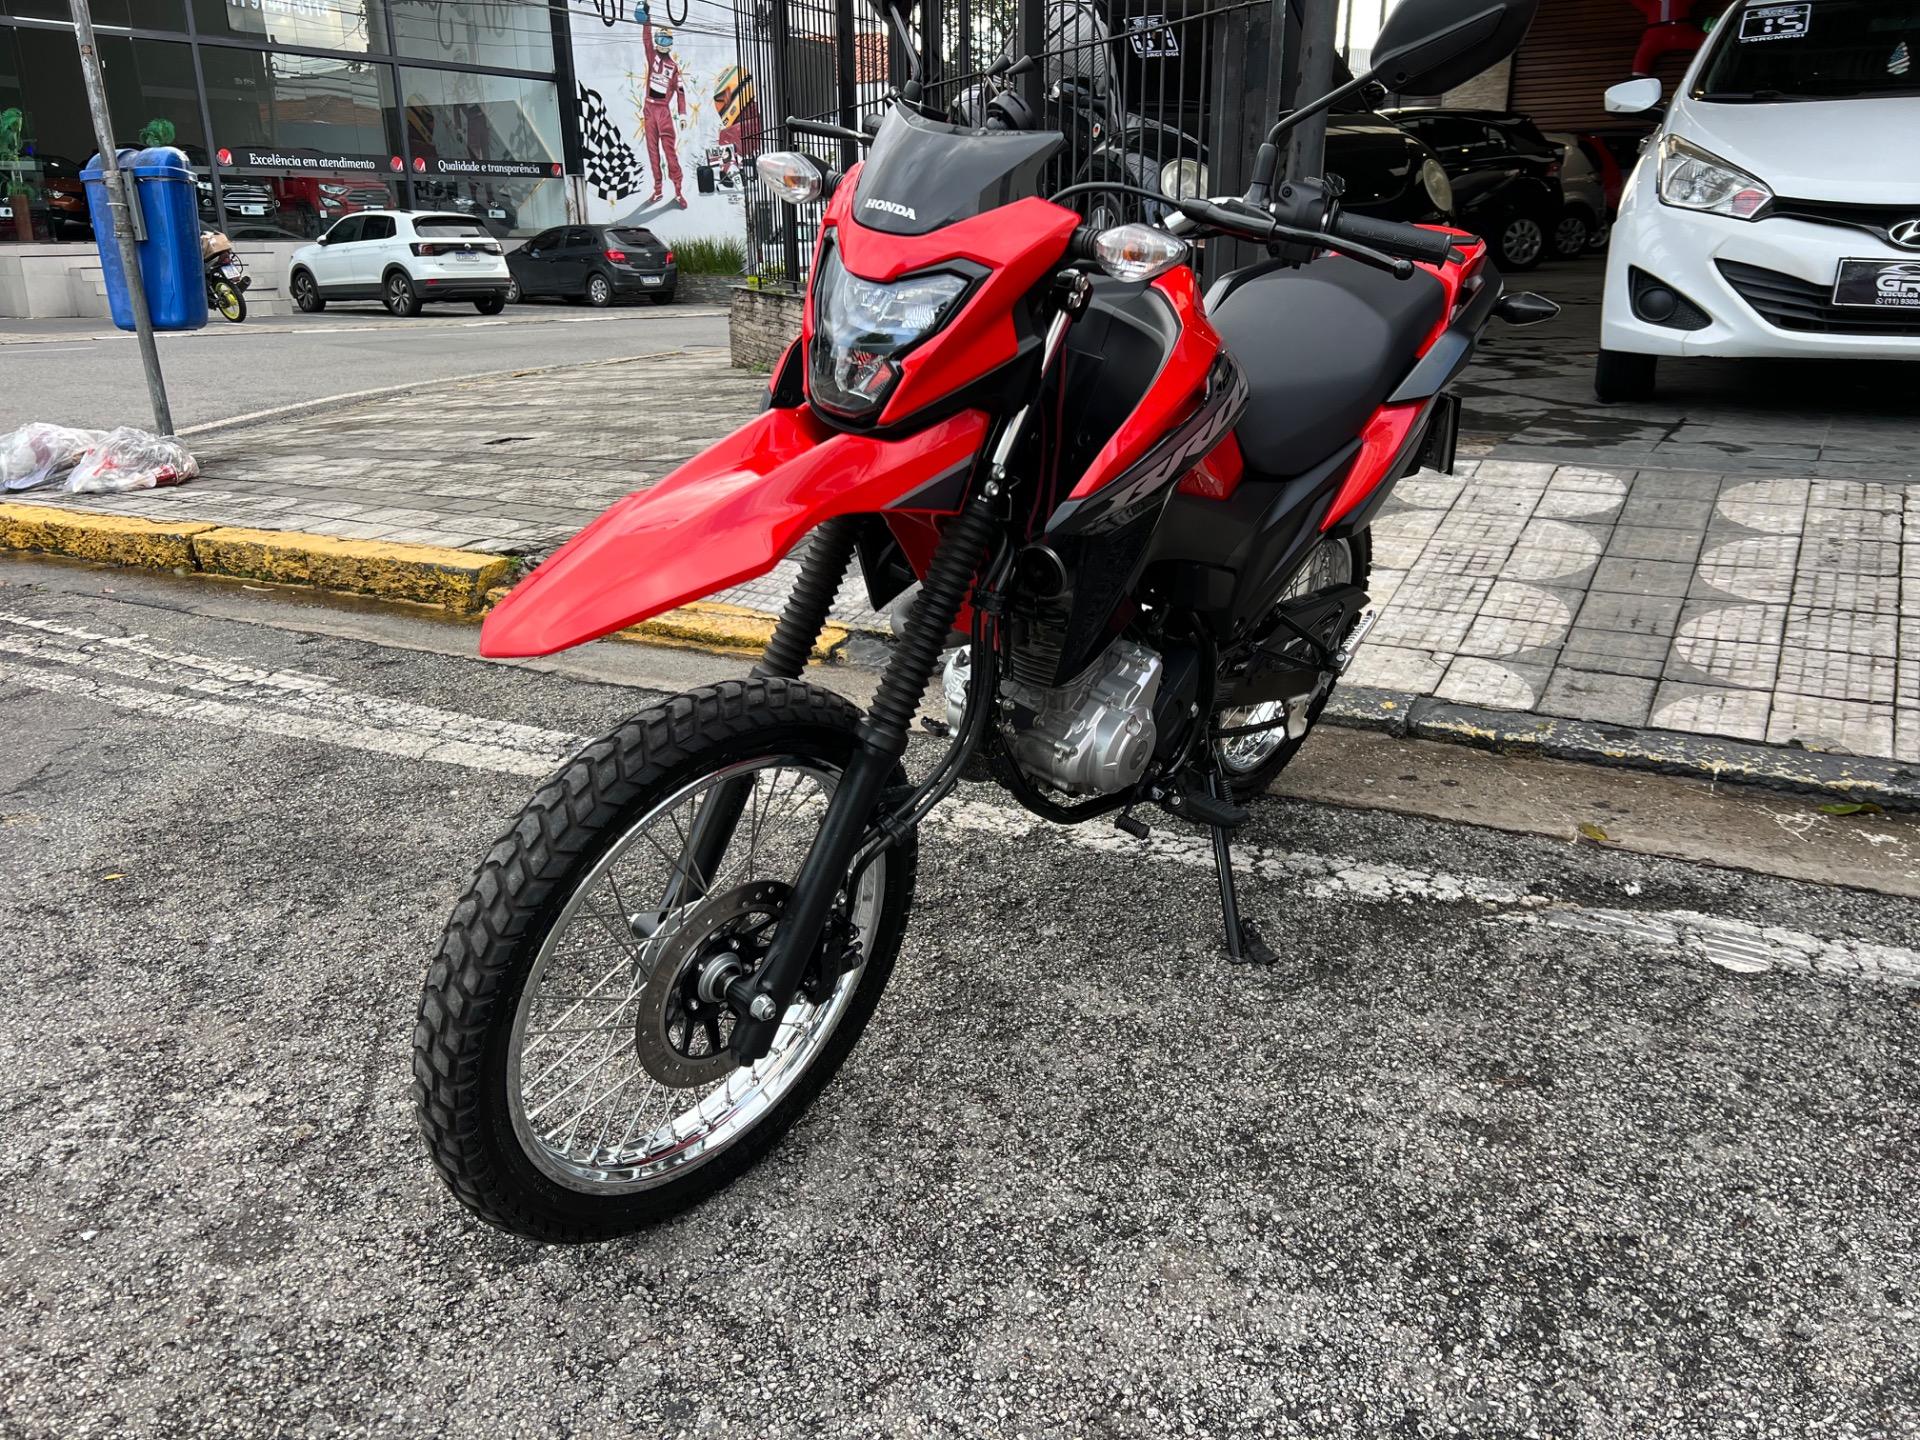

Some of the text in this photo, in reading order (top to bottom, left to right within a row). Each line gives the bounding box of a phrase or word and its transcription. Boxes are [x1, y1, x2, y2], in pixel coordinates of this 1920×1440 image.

[249, 153, 376, 170] Excelência em atendimento
[438, 159, 540, 176] Qualidade e transparência
[865, 198, 917, 221] HONDA
[1884, 297, 1920, 306] (11) 9308
